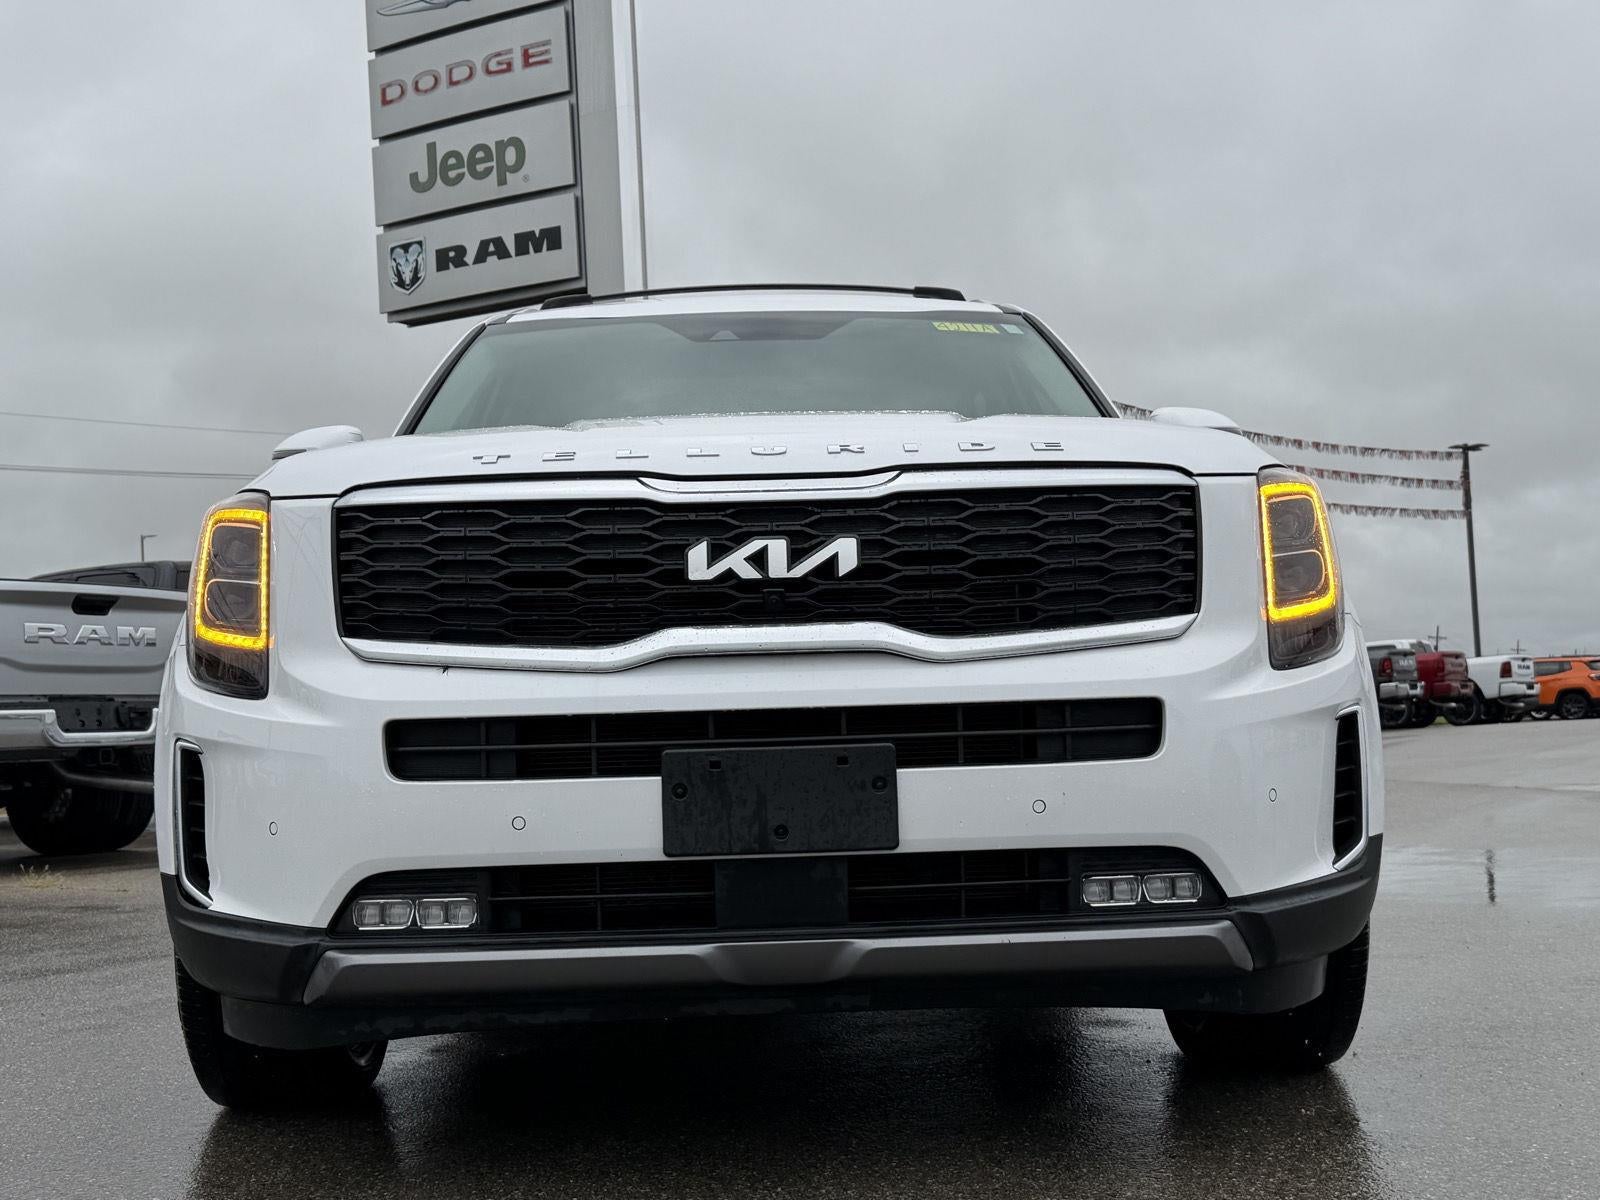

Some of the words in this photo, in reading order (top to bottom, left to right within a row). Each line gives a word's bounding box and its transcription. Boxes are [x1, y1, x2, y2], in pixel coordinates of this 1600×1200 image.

[379, 39, 553, 107] DODGE
[409, 136, 526, 193] Jeep
[435, 225, 562, 273] RAM
[473, 440, 1064, 464] TELLURIDE
[687, 536, 859, 581] KIA
[24, 622, 157, 647] RAM
